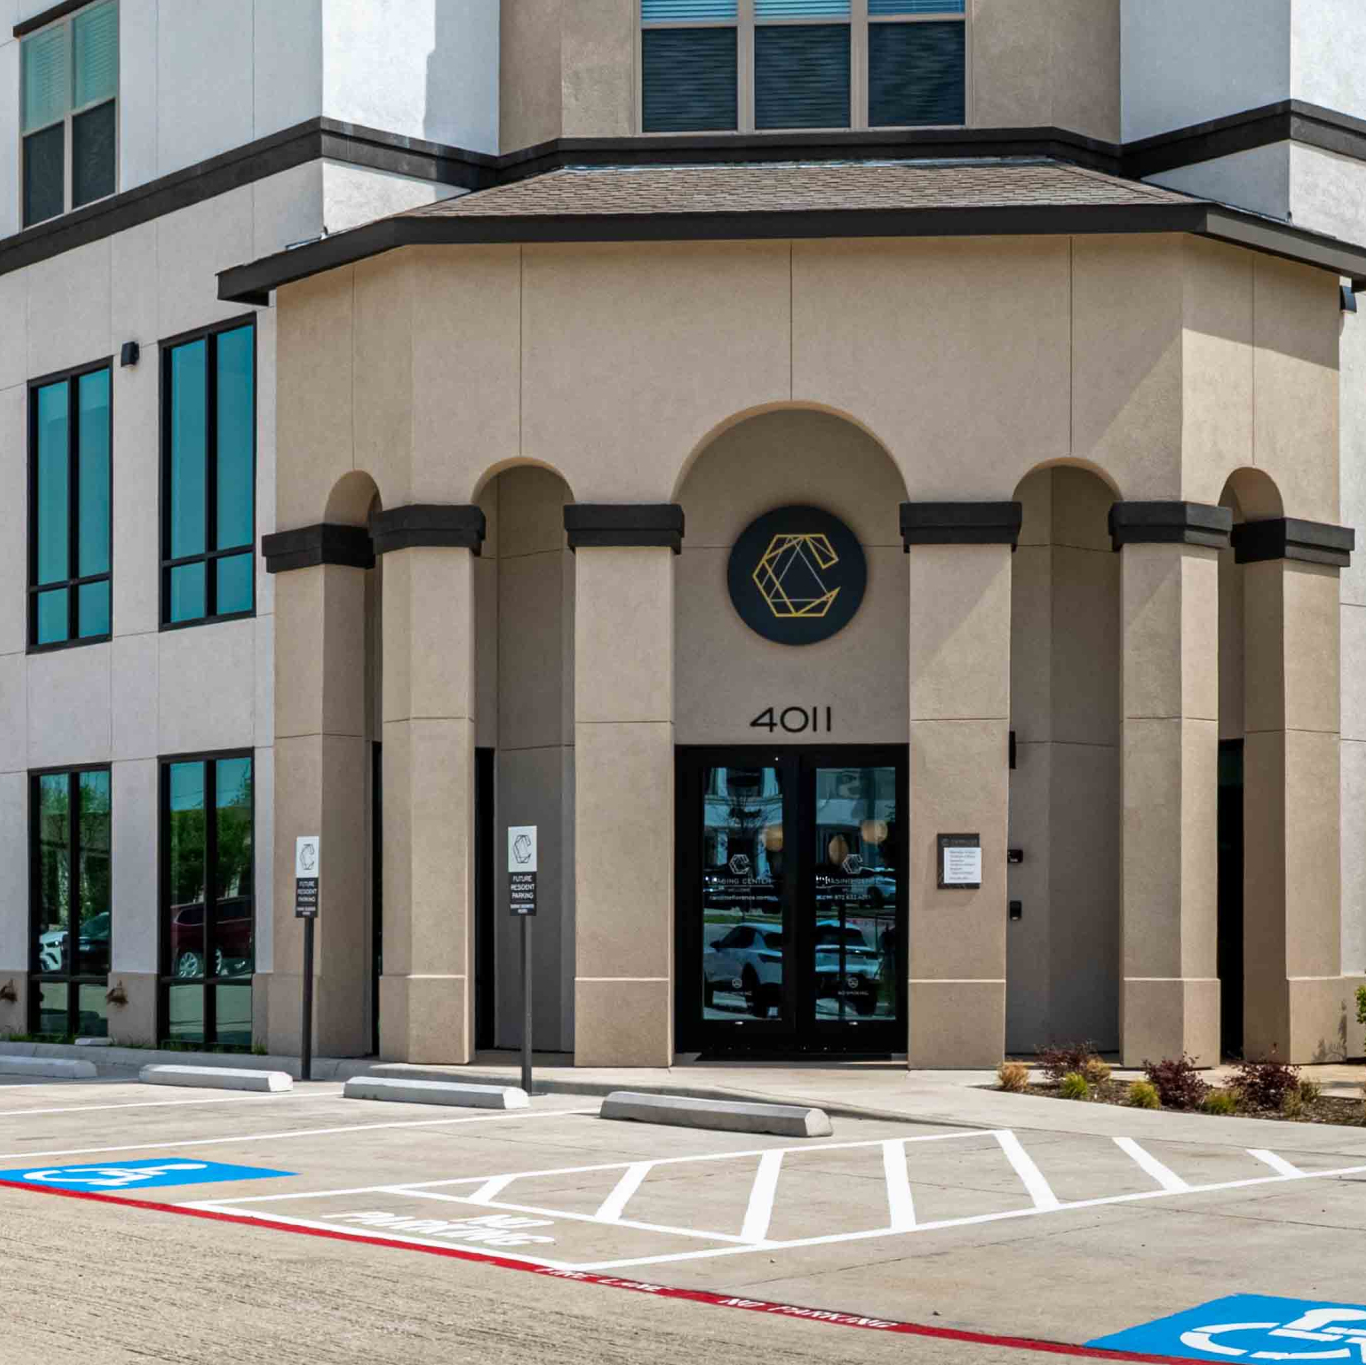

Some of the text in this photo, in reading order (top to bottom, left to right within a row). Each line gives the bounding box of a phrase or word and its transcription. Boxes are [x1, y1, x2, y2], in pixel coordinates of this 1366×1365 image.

[749, 706, 832, 733] 4011
[717, 1297, 899, 1328] NO PARKING
